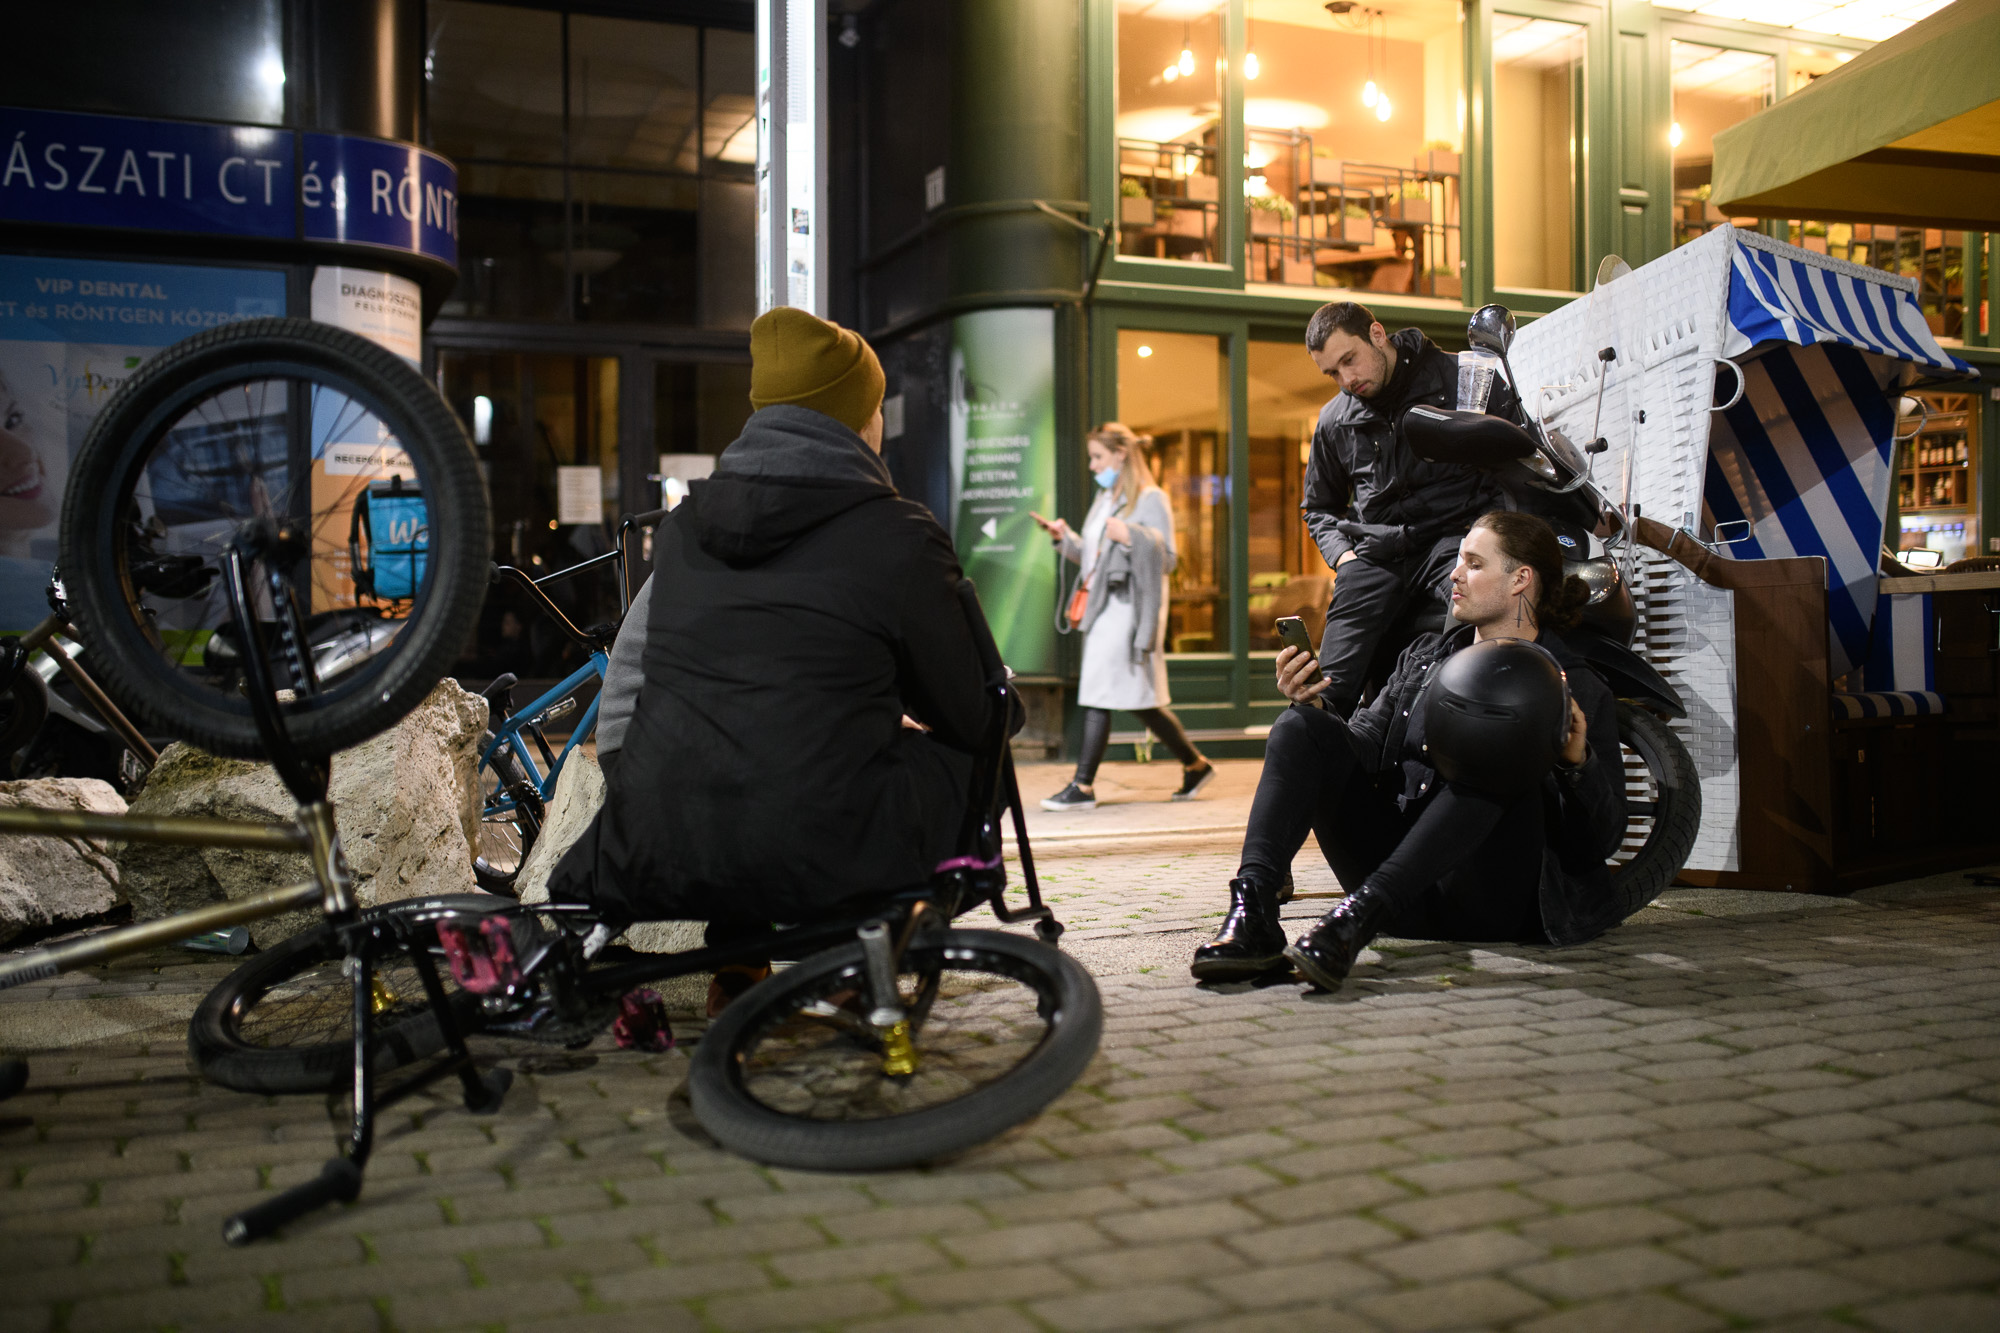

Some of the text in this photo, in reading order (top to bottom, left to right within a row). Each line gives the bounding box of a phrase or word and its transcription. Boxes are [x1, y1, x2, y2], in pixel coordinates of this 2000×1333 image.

[3, 131, 192, 199] ÁSZATI
[219, 156, 282, 206] CT
[302, 160, 346, 211] és
[35, 277, 168, 300] VIP DENTAL
[25, 302, 49, 319] és
[55, 304, 164, 325] RÖNTGEN
